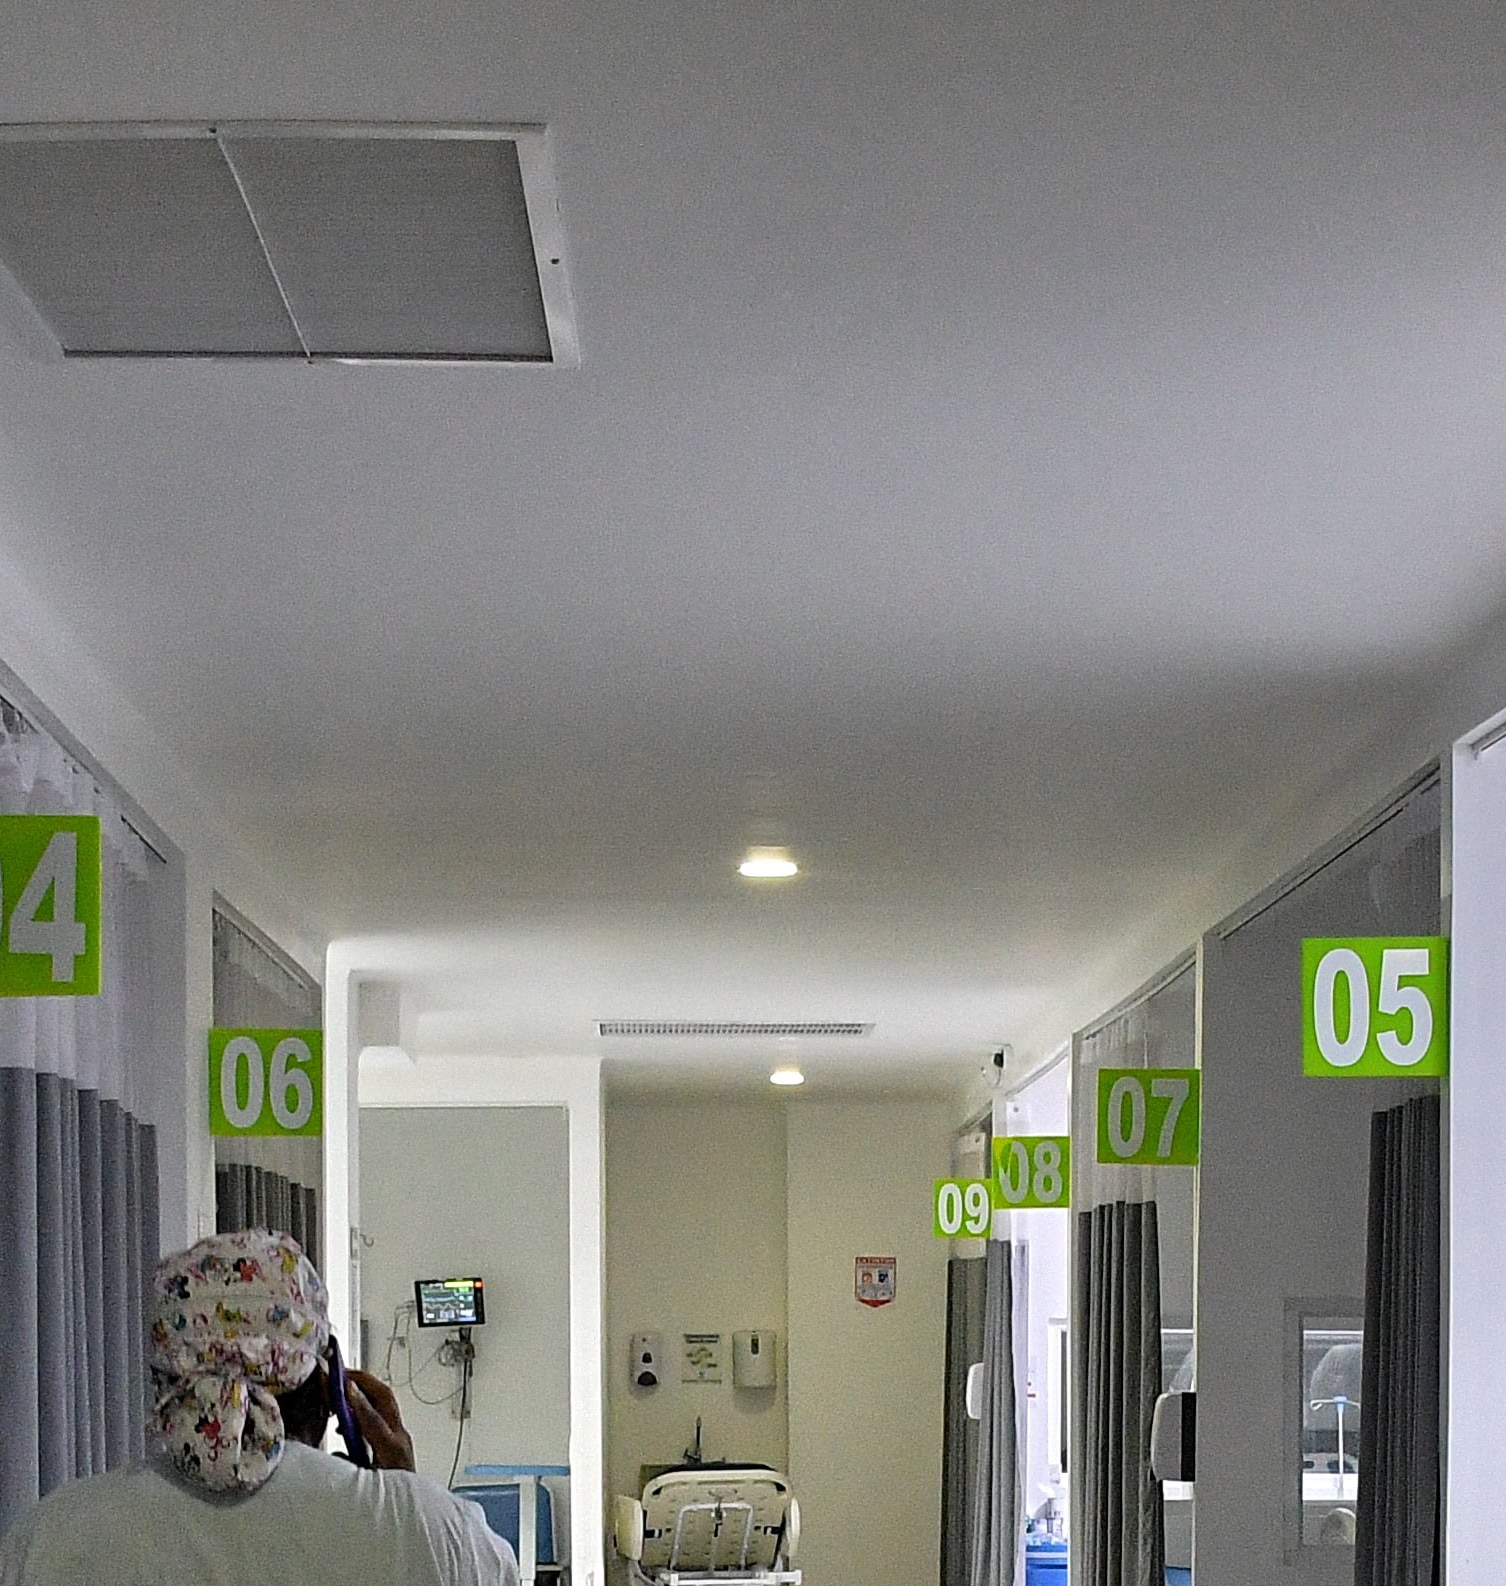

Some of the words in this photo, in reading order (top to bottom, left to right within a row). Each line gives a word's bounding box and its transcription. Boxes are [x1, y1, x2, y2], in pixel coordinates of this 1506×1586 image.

[1314, 948, 1433, 1067] 05
[221, 1036, 313, 1129] 06
[1108, 1076, 1189, 1158] 07
[938, 1183, 989, 1235] 09
[999, 1141, 1062, 1203] 08
